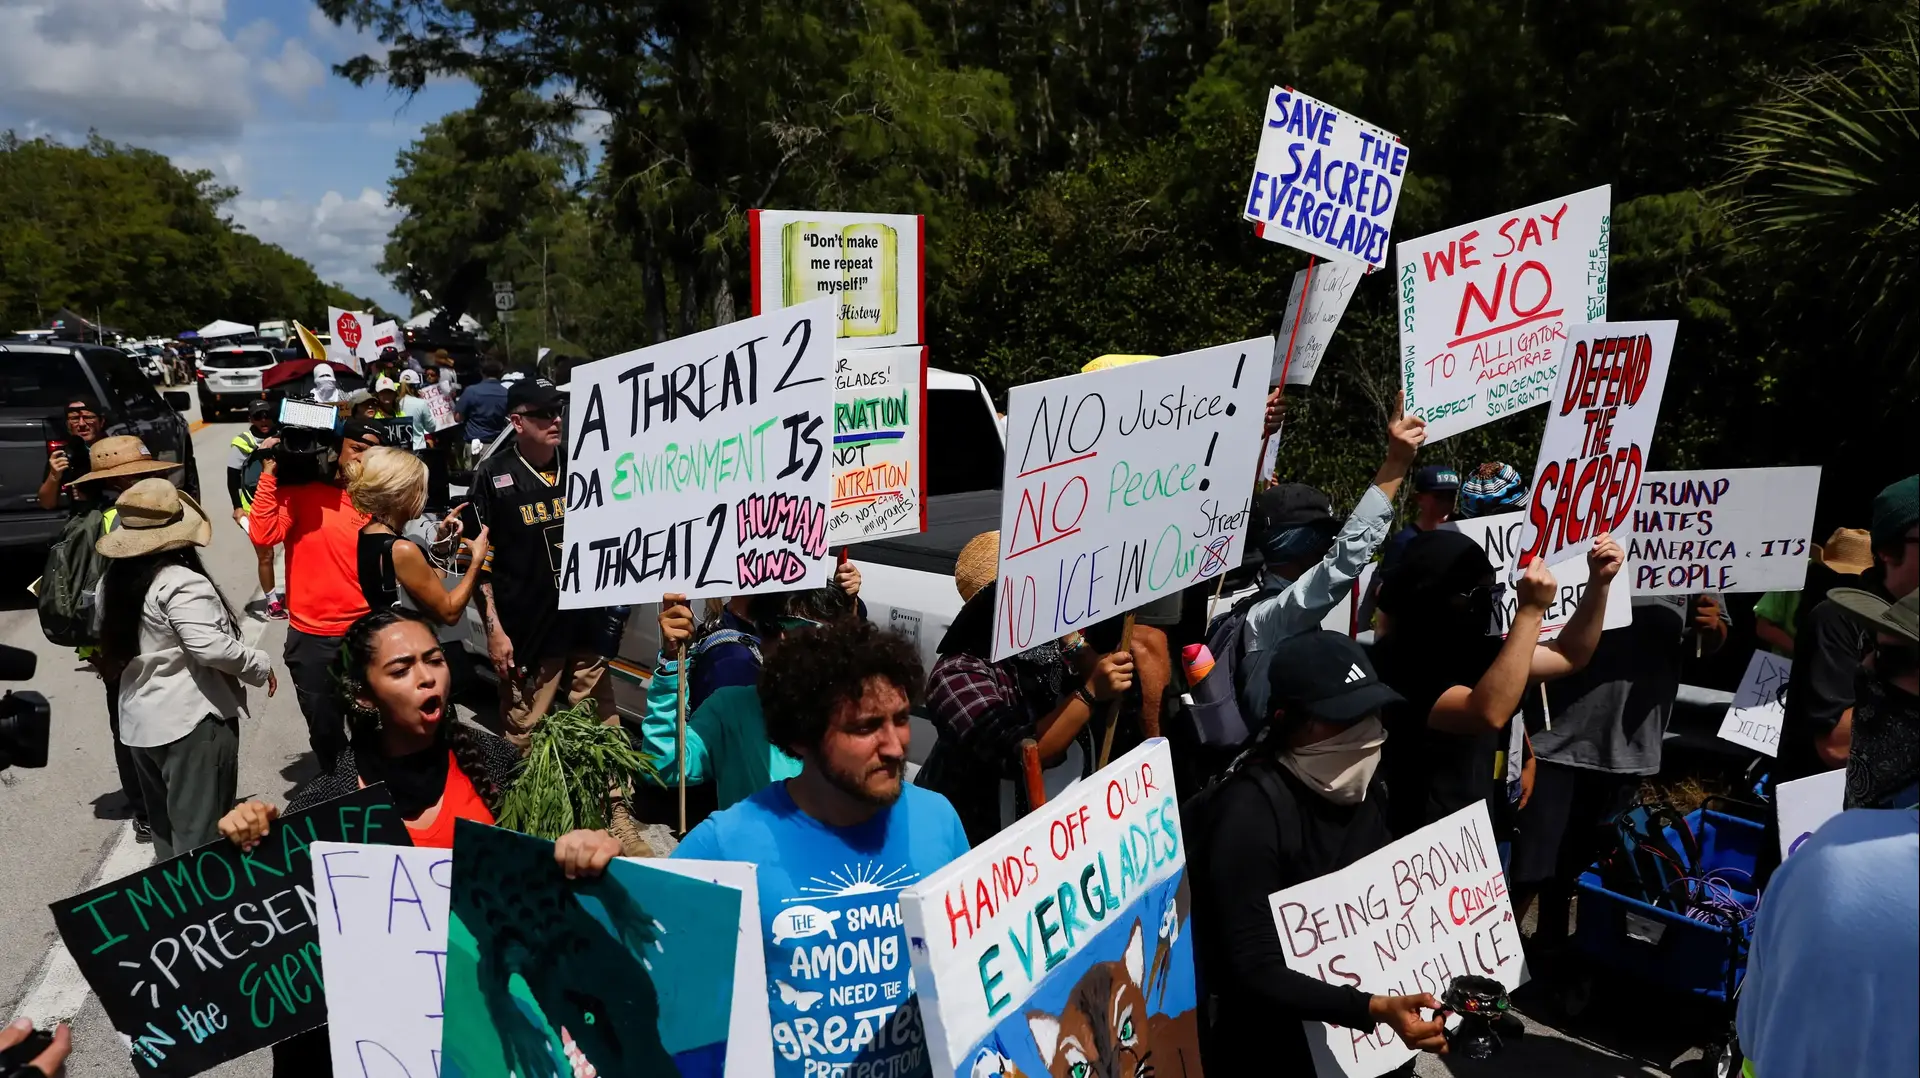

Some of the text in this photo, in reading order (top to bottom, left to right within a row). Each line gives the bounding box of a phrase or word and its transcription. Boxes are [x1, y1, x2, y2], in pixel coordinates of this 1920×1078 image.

[1268, 92, 1408, 177] SAVE THE
[1280, 143, 1393, 217] SACRED
[846, 235, 879, 248] make
[1247, 171, 1389, 264] EVERGLADES
[1422, 202, 1568, 282] WE SAY
[810, 256, 873, 272] me repeat
[1587, 248, 1598, 286] THE
[1596, 215, 1611, 318] EVERGLADES
[1454, 260, 1553, 337] NO
[345, 331, 358, 344] ICE
[1400, 262, 1416, 412] RESPECT MIGRANTS
[1424, 321, 1567, 387] TO ALLIGATOR
[1475, 348, 1552, 385] ALCATRAZ
[572, 319, 826, 460] A THREAT 2
[835, 365, 891, 390] GLADES!
[1413, 365, 1558, 423] RESPECT INDIGENOUS
[1559, 333, 1653, 417] DEFEND
[566, 410, 825, 513] DA ENVIRONMENT IS
[832, 443, 871, 467] NOT
[1020, 393, 1105, 474] NO
[1580, 407, 1617, 460] THE
[833, 460, 910, 498] NTRATION
[856, 501, 877, 523] NOT
[1517, 441, 1643, 571] SACRED
[1637, 478, 1730, 507] TRUMP
[561, 491, 828, 593] A THREAT 2 HUMAN
[1010, 475, 1089, 554] NO
[1633, 509, 1713, 536] HATES
[736, 548, 807, 589] KIND
[994, 575, 1036, 662] NO
[1054, 545, 1109, 633] ICE
[1115, 539, 1147, 606] IN
[1148, 524, 1200, 591] Our
[1193, 498, 1250, 538] Street
[1636, 563, 1737, 592] PEOPLE
[944, 762, 1160, 949] HANDS OFF OUR
[1278, 819, 1487, 958] BEING BROWN
[788, 914, 816, 931] THE
[978, 796, 1179, 1018] EVERGLADES
[1373, 904, 1421, 971] NOT
[1430, 906, 1449, 942] A
[177, 1002, 228, 1043] the
[829, 981, 902, 1006] NEED THE
